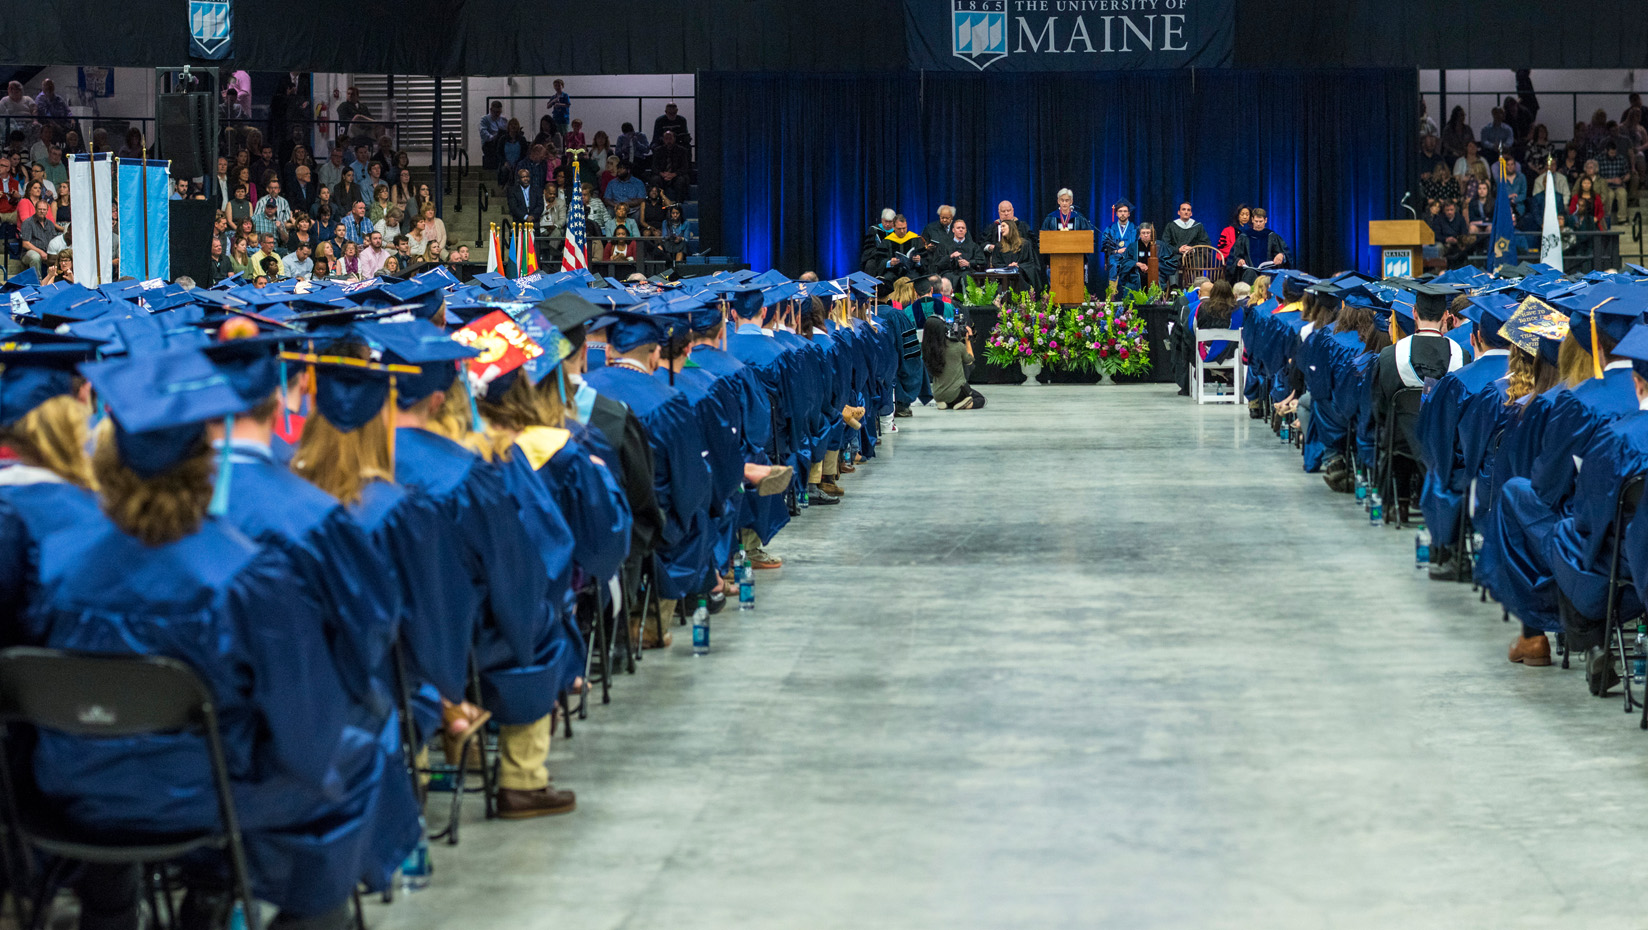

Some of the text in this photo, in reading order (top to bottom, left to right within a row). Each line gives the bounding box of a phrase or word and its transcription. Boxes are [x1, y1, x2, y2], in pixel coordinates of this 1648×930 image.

[957, 1, 1002, 11] 1865
[1015, 0, 1187, 11] THE UNIVERSITY OF
[1013, 15, 1188, 52] MAINE
